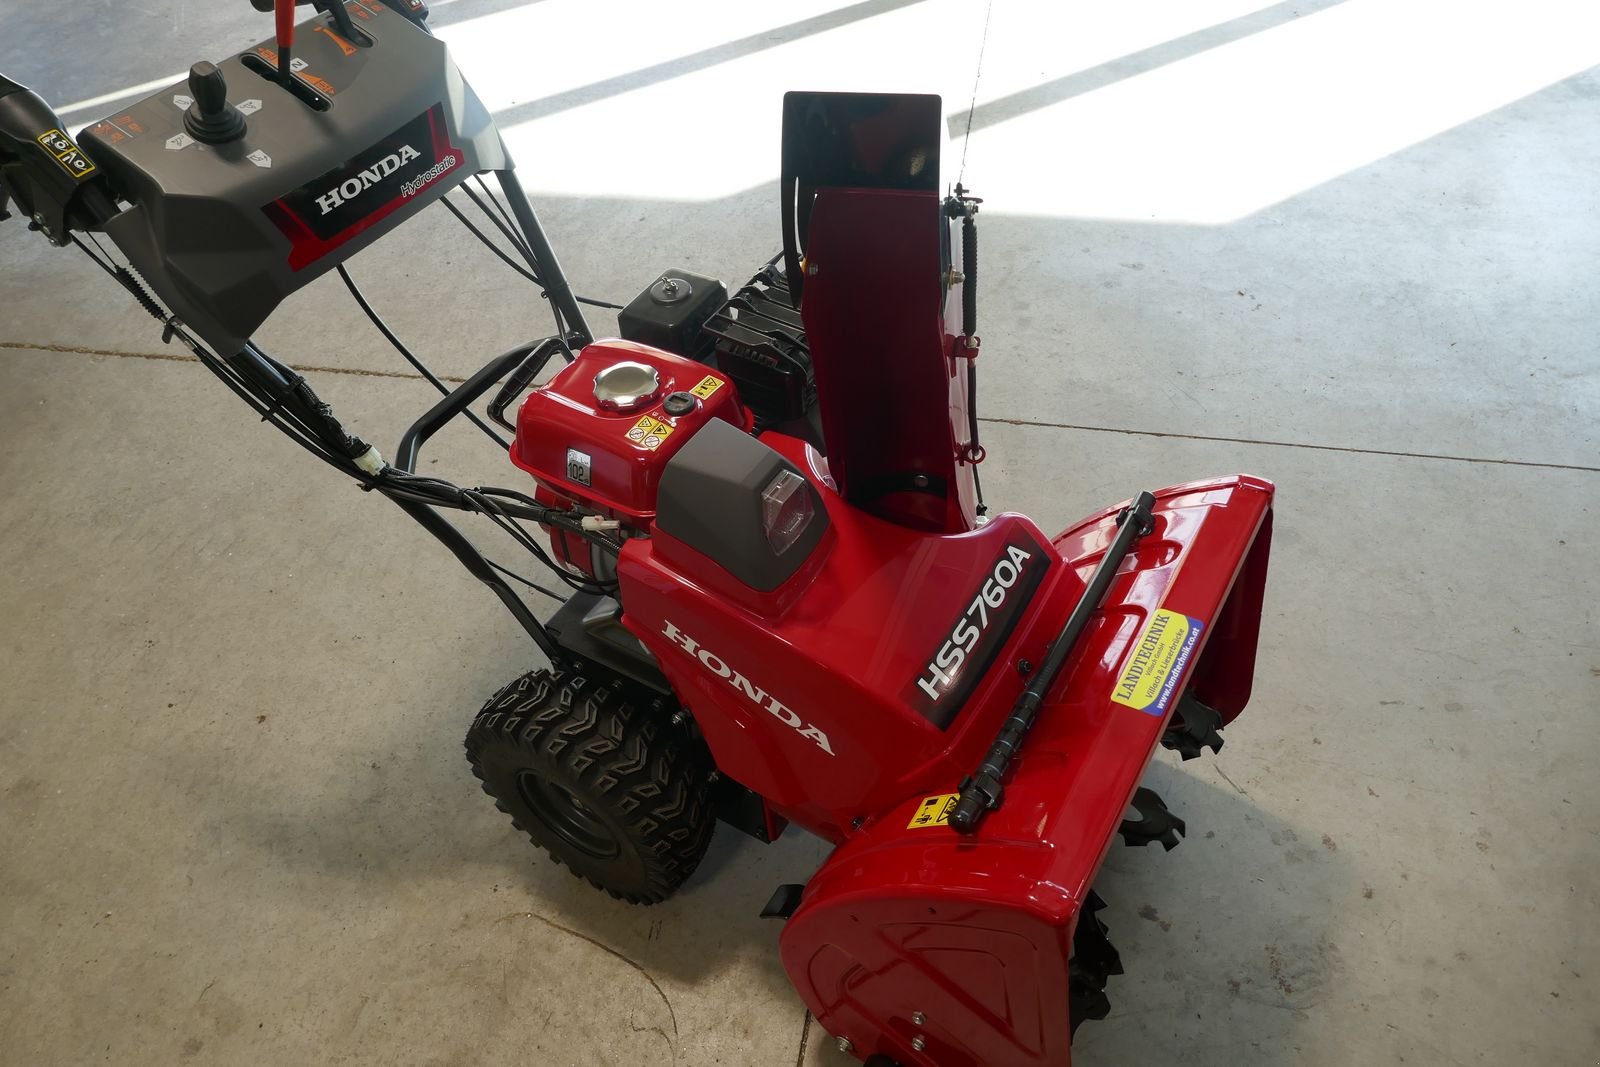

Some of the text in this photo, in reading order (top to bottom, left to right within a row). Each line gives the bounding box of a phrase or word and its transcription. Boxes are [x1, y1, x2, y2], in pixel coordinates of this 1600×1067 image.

[315, 144, 421, 216] HONDA
[401, 154, 456, 198] Hydrostatic
[568, 462, 584, 482] 102
[917, 545, 1031, 701] HSS760A
[1117, 614, 1170, 700] LANDTECHNIK
[661, 619, 836, 757] HONDA
[1146, 628, 1184, 698] Villach & Lieserbrücke
[1146, 657, 1158, 676] Villach
[1156, 627, 1200, 709] www.landtechnik.co.at
